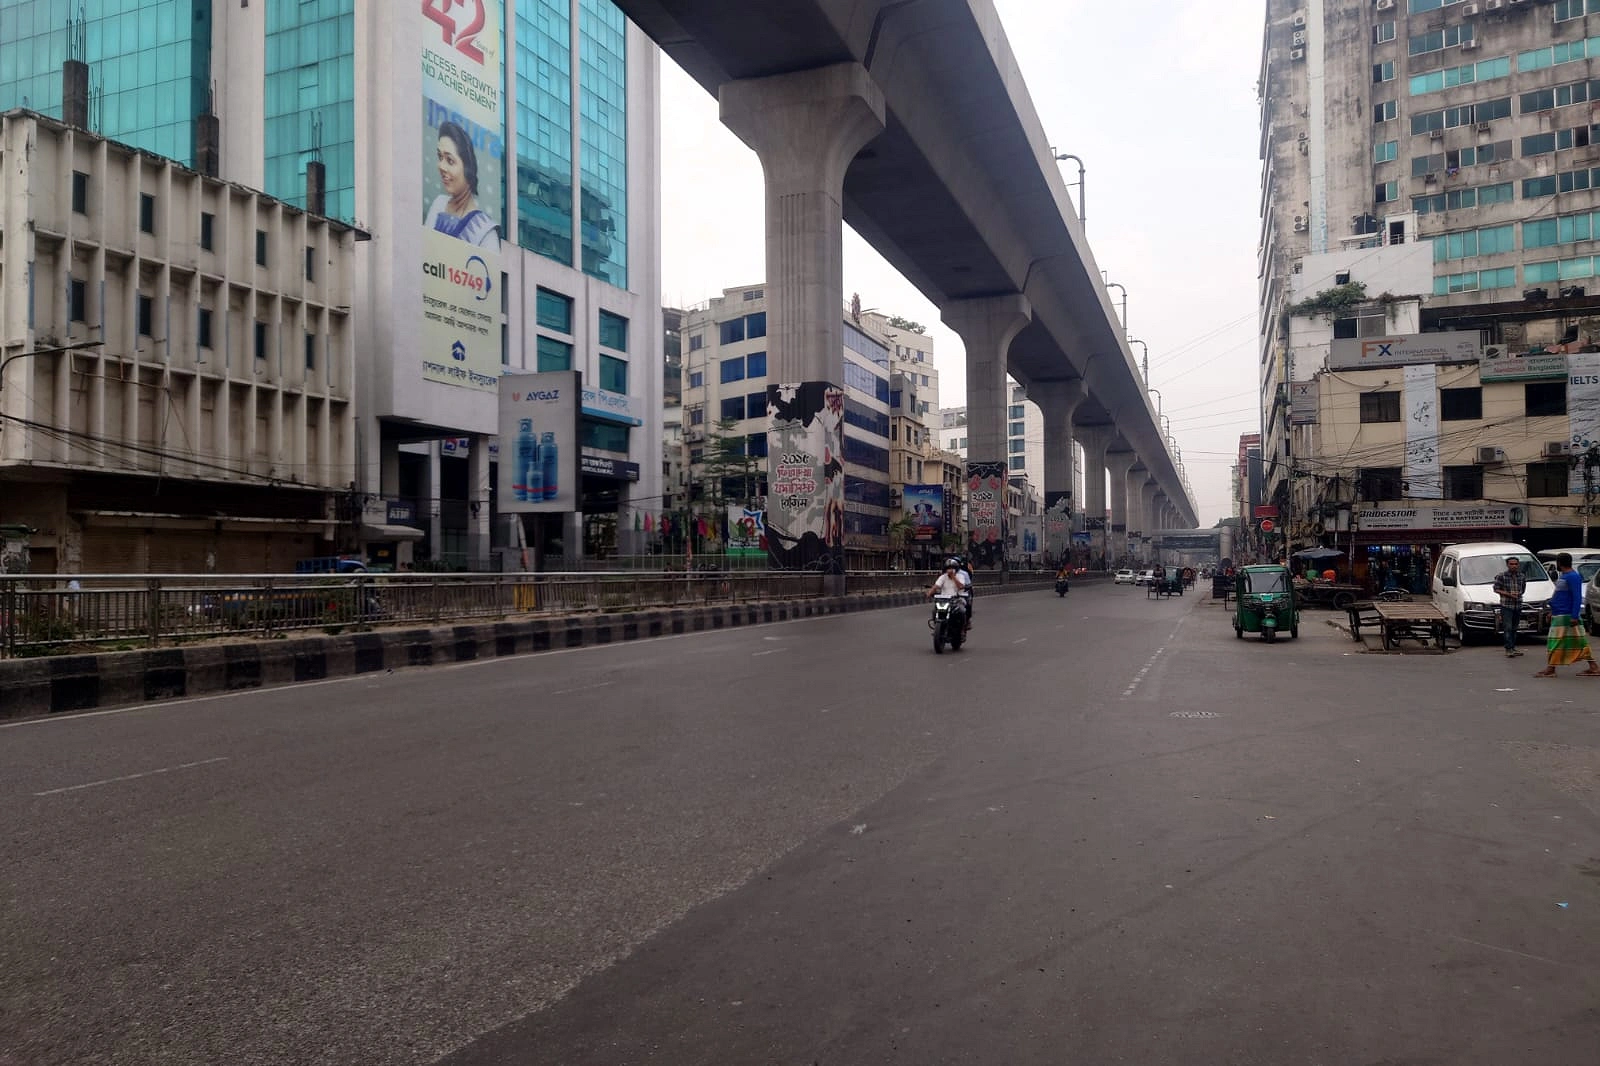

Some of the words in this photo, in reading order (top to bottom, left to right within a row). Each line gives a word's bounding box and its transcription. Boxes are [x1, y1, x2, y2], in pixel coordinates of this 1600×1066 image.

[460, 70, 497, 100] GROWTH
[437, 72, 497, 113] ACHIEVEMENT
[422, 262, 446, 280] call
[448, 268, 483, 291] 16749
[1570, 376, 1599, 385] IELTS
[526, 390, 560, 401] AYGAZ
[389, 508, 409, 519] ATM
[1360, 510, 1417, 518] BRIDGESTONE
